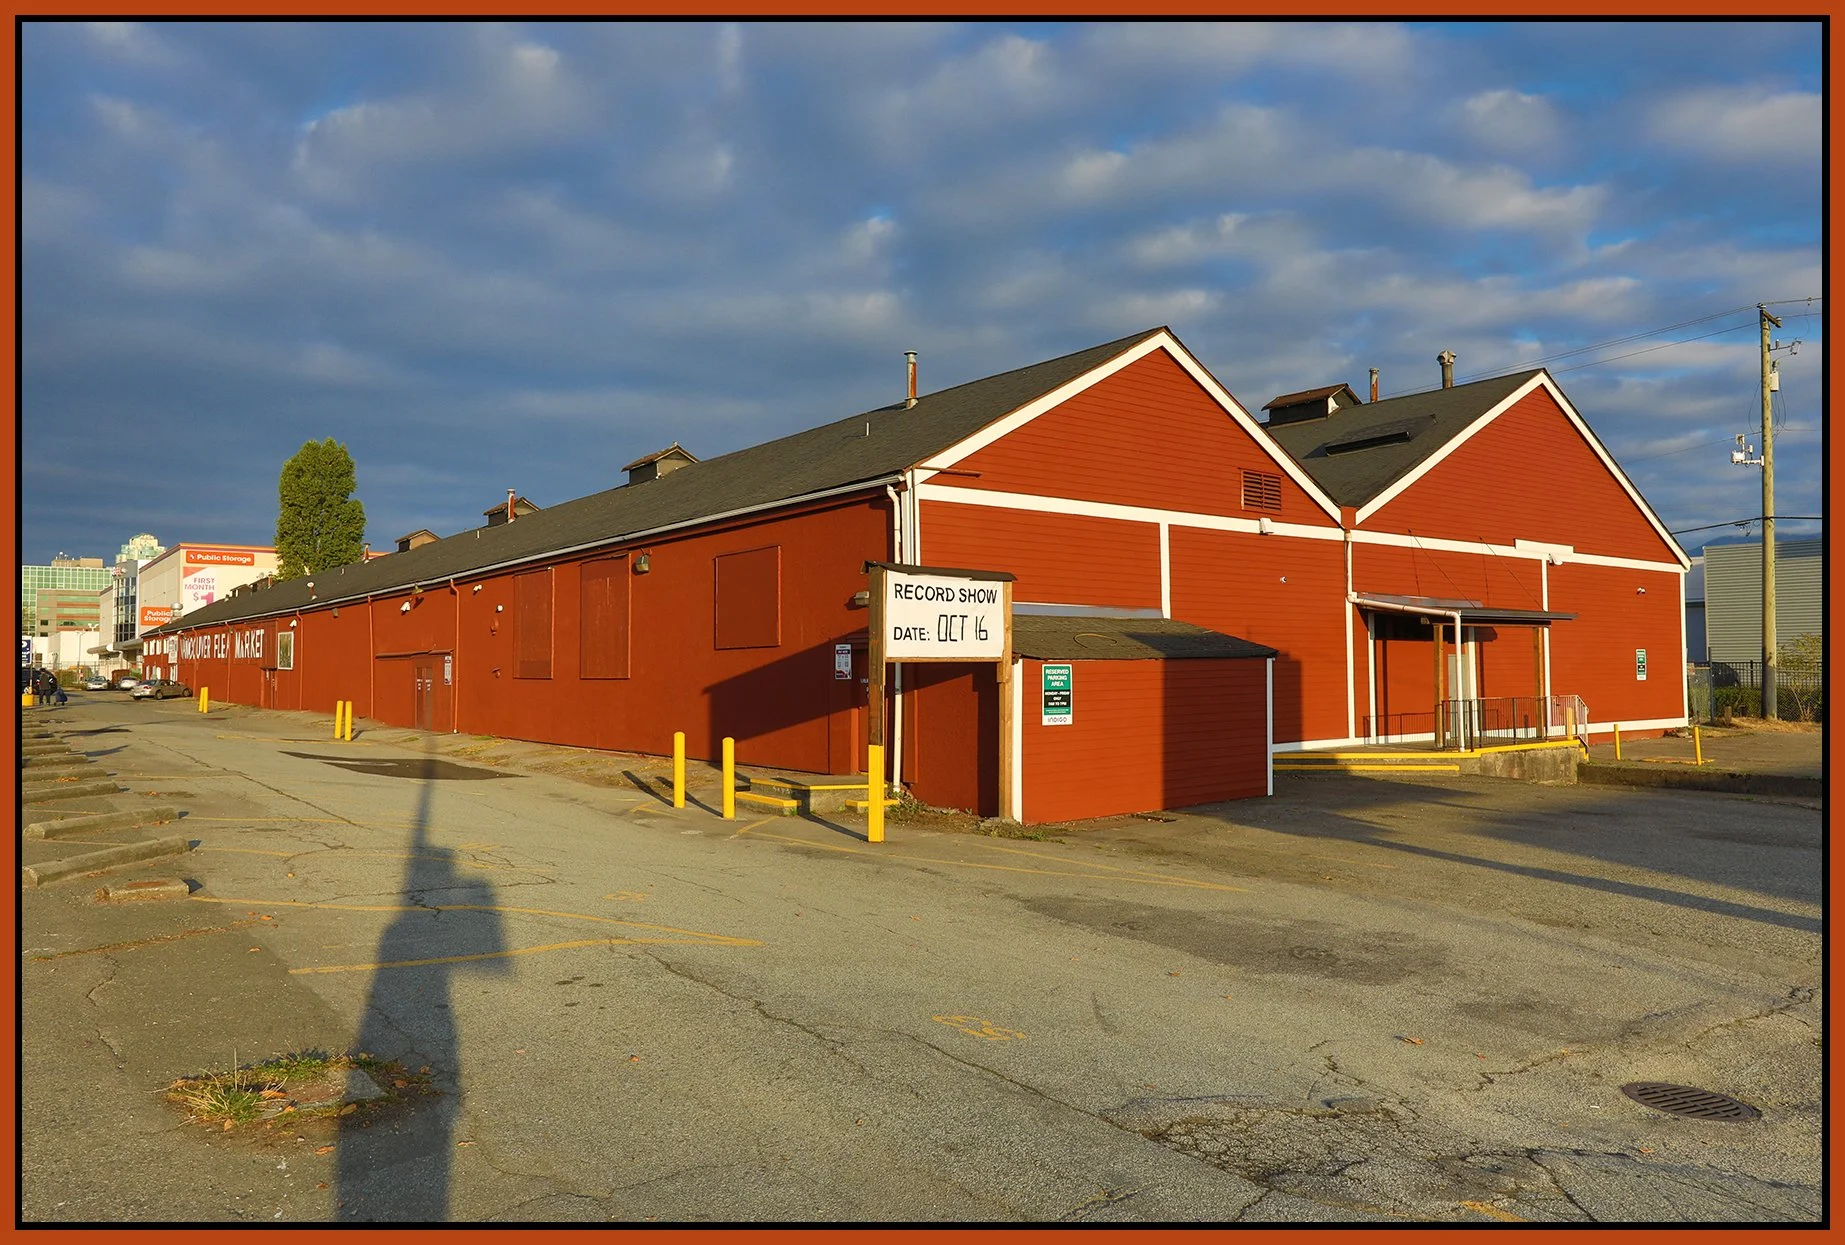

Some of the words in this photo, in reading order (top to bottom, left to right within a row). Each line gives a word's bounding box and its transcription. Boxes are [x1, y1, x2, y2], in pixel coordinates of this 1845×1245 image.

[197, 553, 222, 561] Public
[222, 555, 252, 564] Storage
[894, 583, 955, 602] RECORD
[959, 588, 997, 604] SHOW
[144, 615, 172, 624] Storag
[893, 626, 930, 641] DATE:
[938, 614, 968, 642] OCT
[975, 615, 988, 641] 16
[234, 629, 265, 659] MARKET
